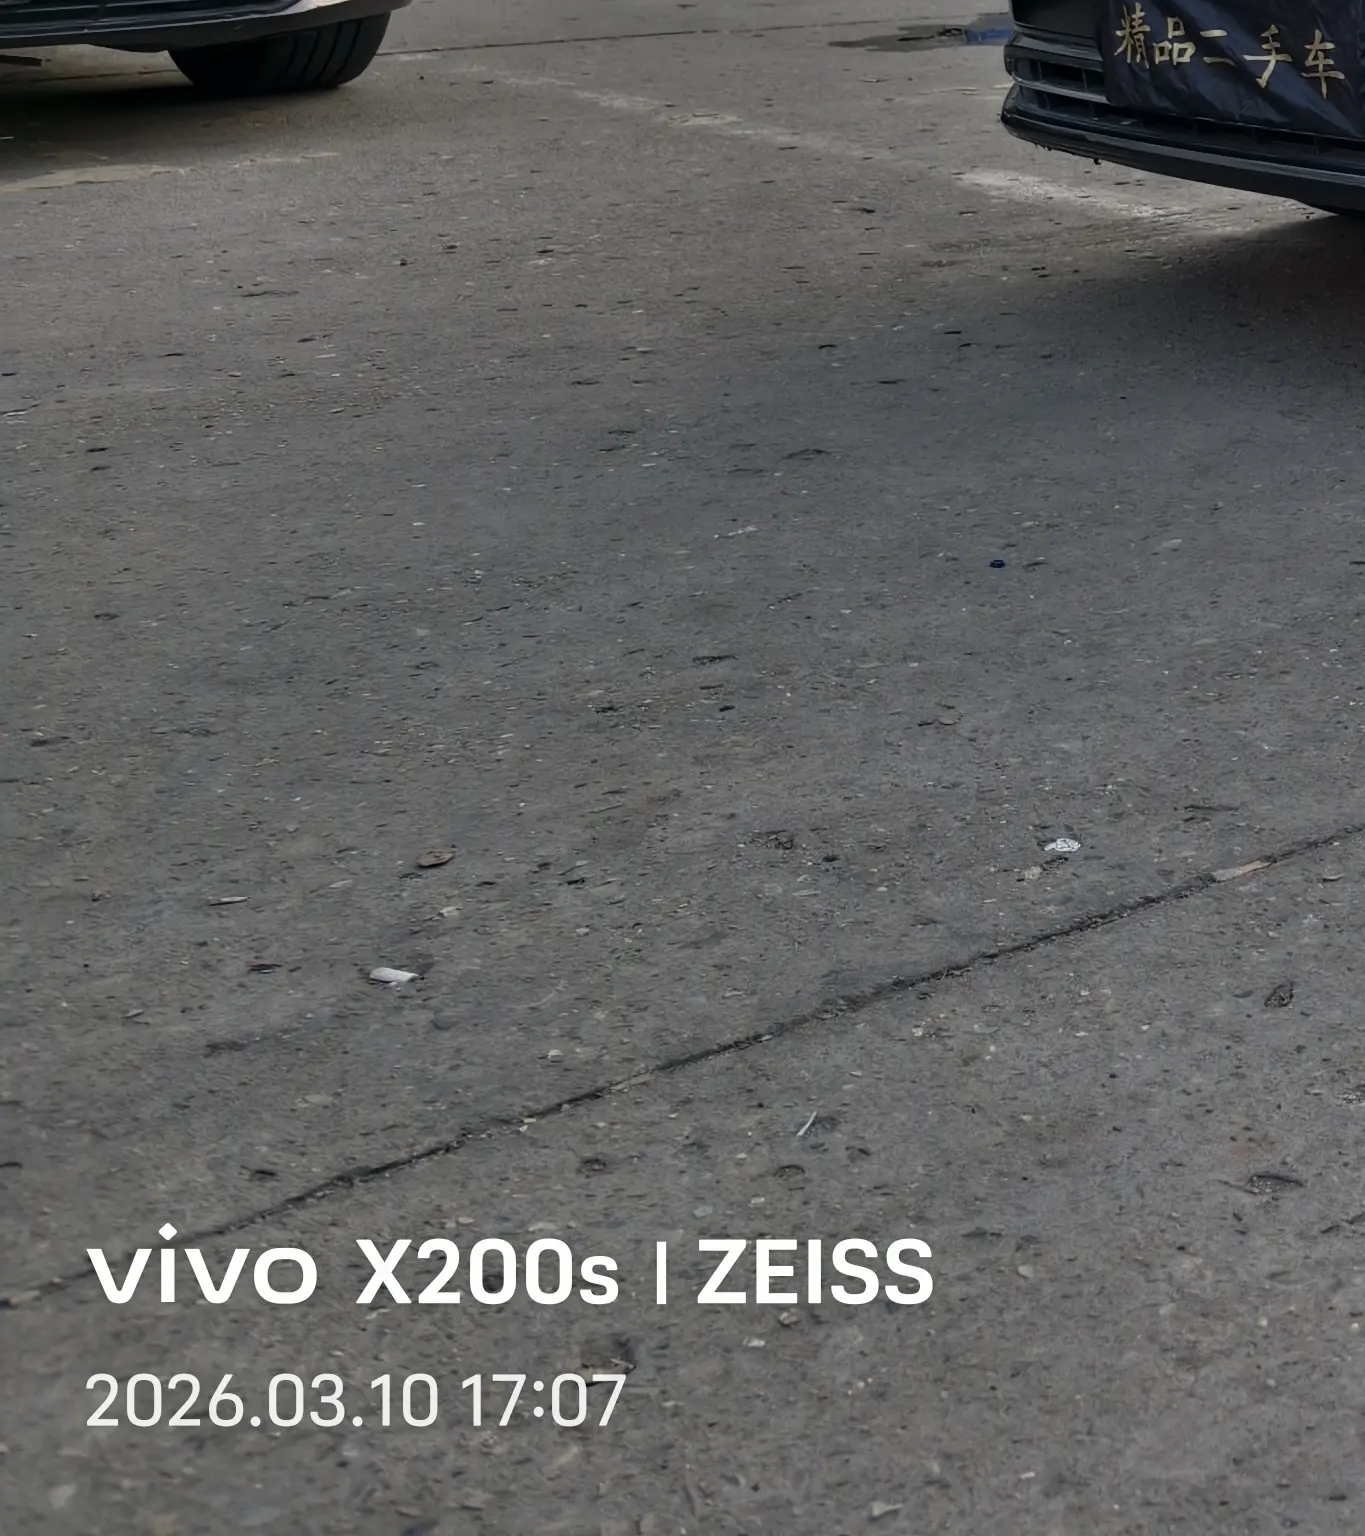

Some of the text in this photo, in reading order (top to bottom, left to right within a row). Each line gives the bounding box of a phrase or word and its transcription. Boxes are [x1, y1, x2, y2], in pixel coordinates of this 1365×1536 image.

[1113, 1, 1346, 100] 精品二手车
